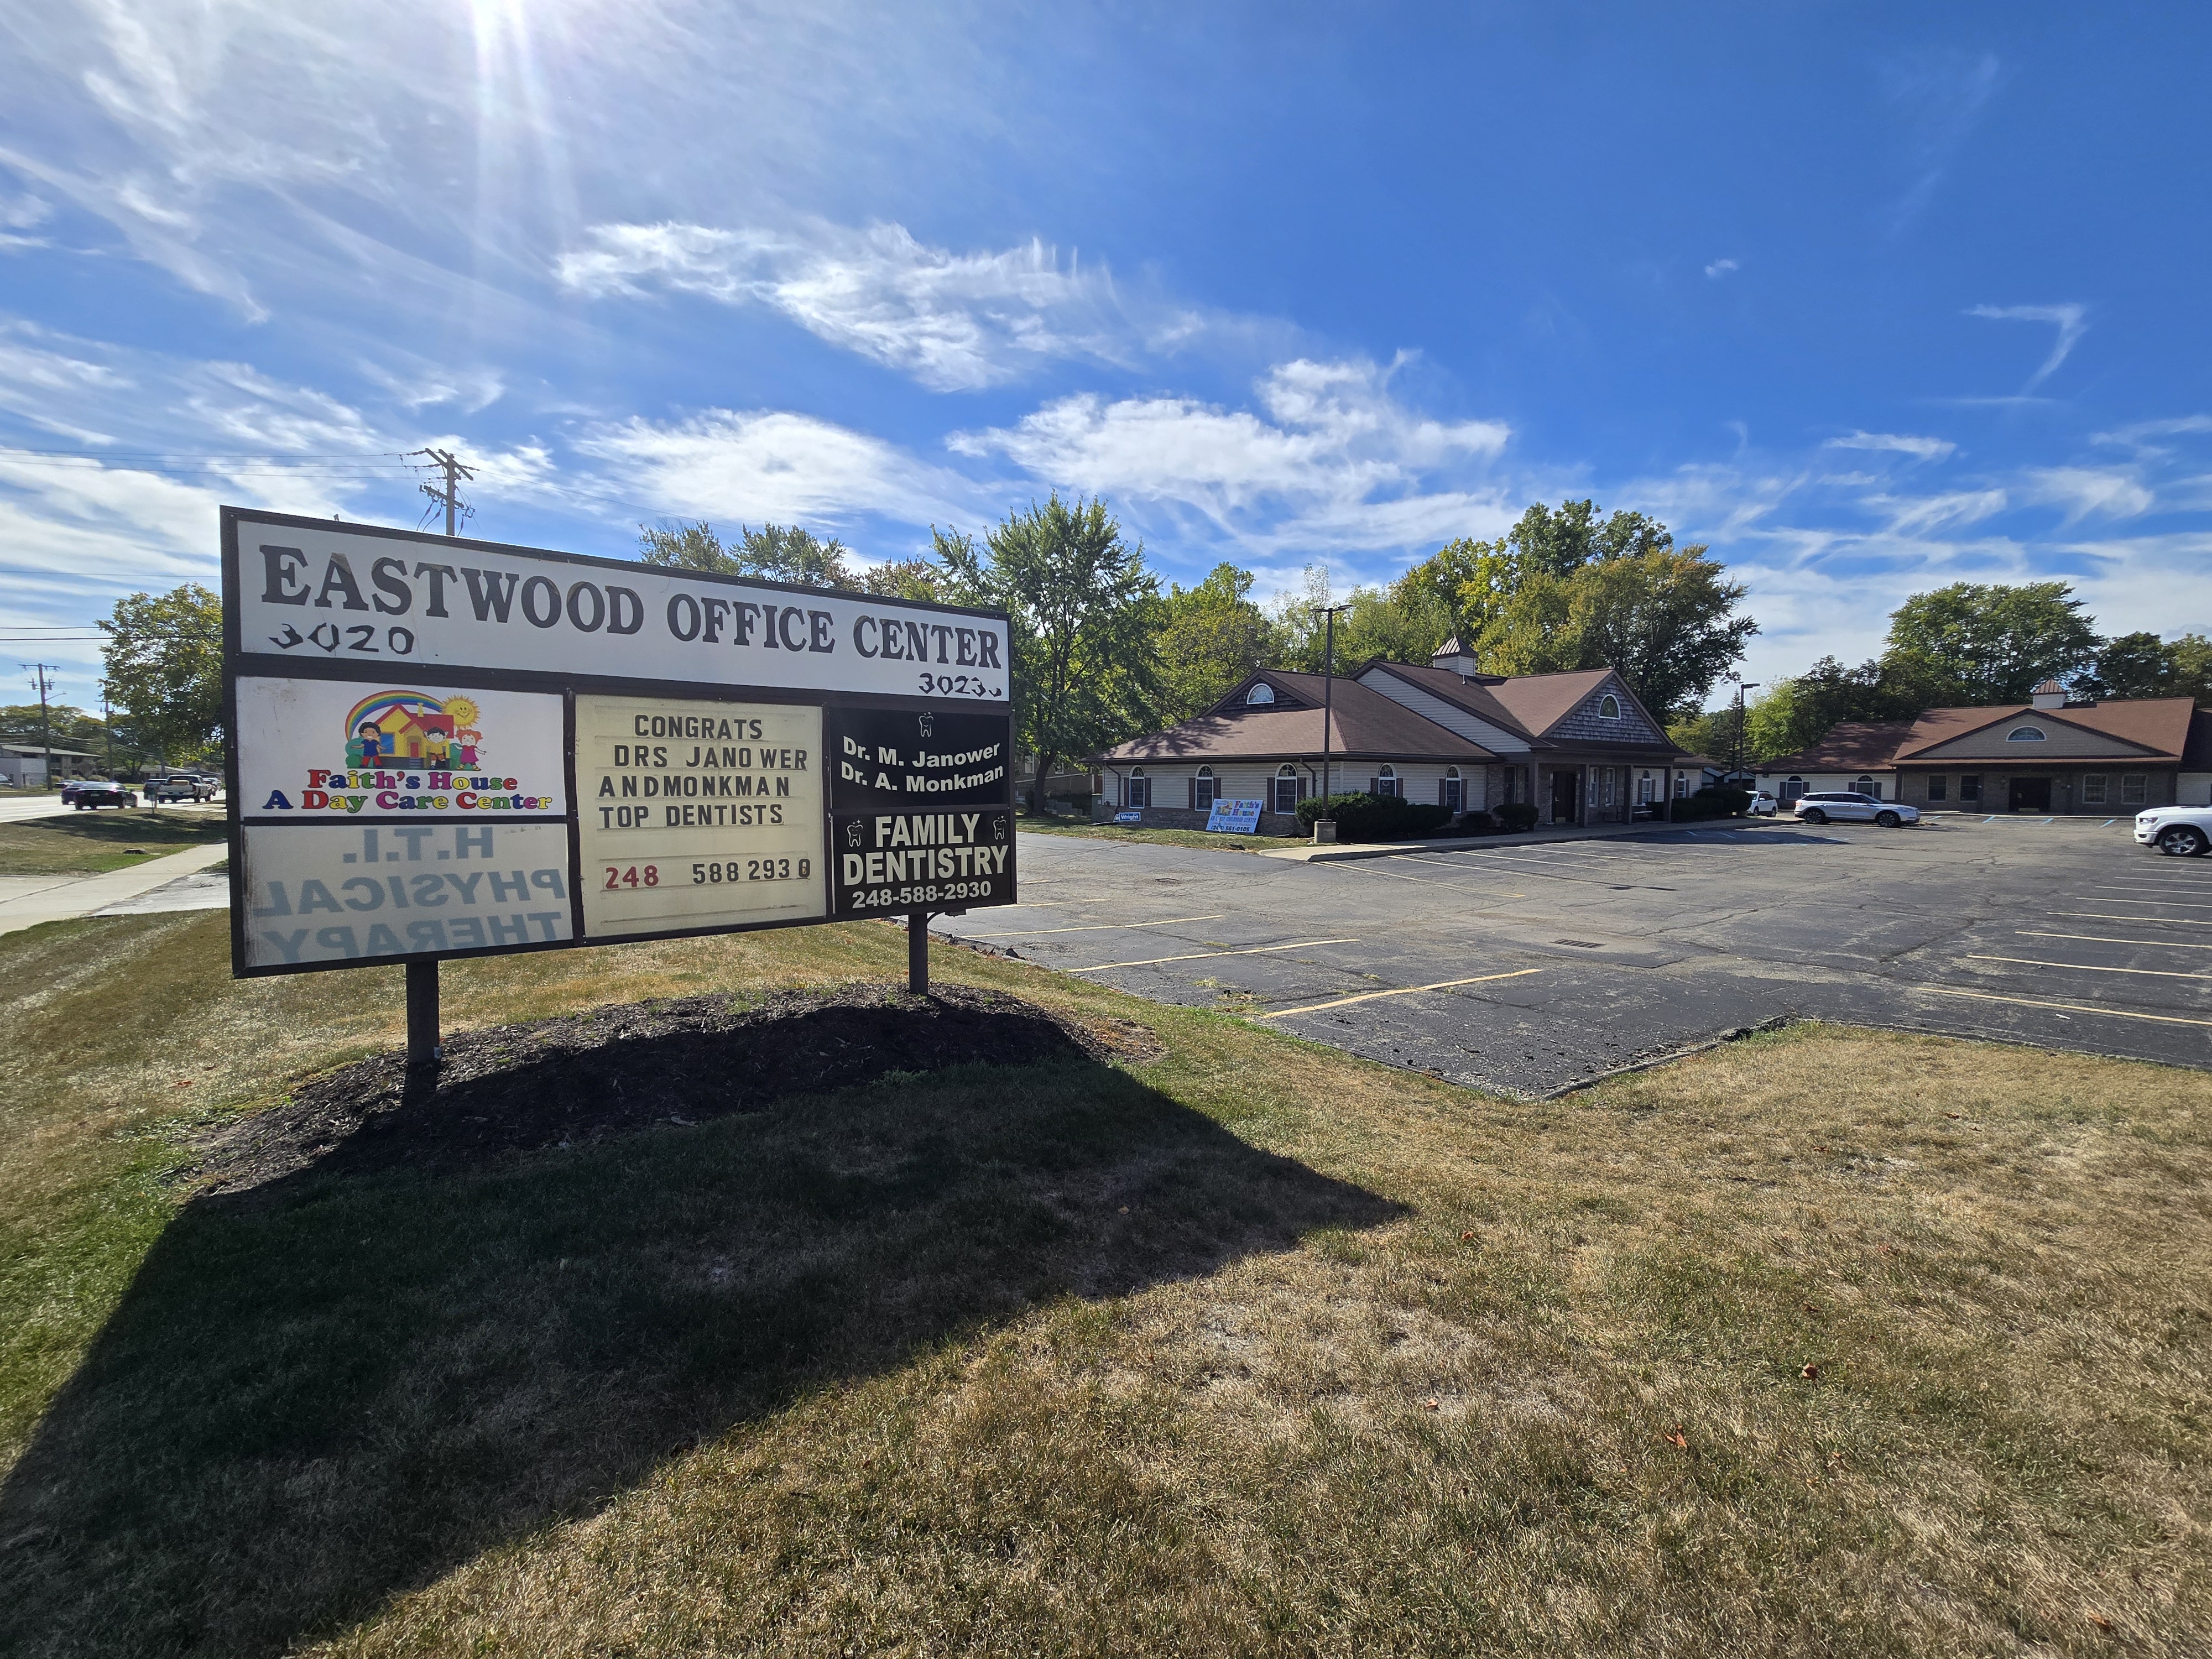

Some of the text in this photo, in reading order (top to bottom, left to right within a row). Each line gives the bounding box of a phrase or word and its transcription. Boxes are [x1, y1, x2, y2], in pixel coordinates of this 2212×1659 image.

[259, 544, 1001, 669] EASTWOOD OFFICE CENTER
[268, 623, 415, 655] 3020
[634, 714, 763, 739] CONGRATS
[614, 745, 667, 768] DRS
[843, 736, 1000, 768] Dr. M. Janower
[307, 769, 518, 790] Faith's House
[841, 761, 1003, 792] Dr. A. Monkman
[262, 790, 552, 813] A Day Care Center
[599, 804, 782, 828] TOP DENTISTS
[875, 813, 980, 847] FAMILY
[605, 865, 659, 889] 248
[843, 845, 1009, 886] DENTISTRY
[852, 880, 992, 909] 248-588-2930
